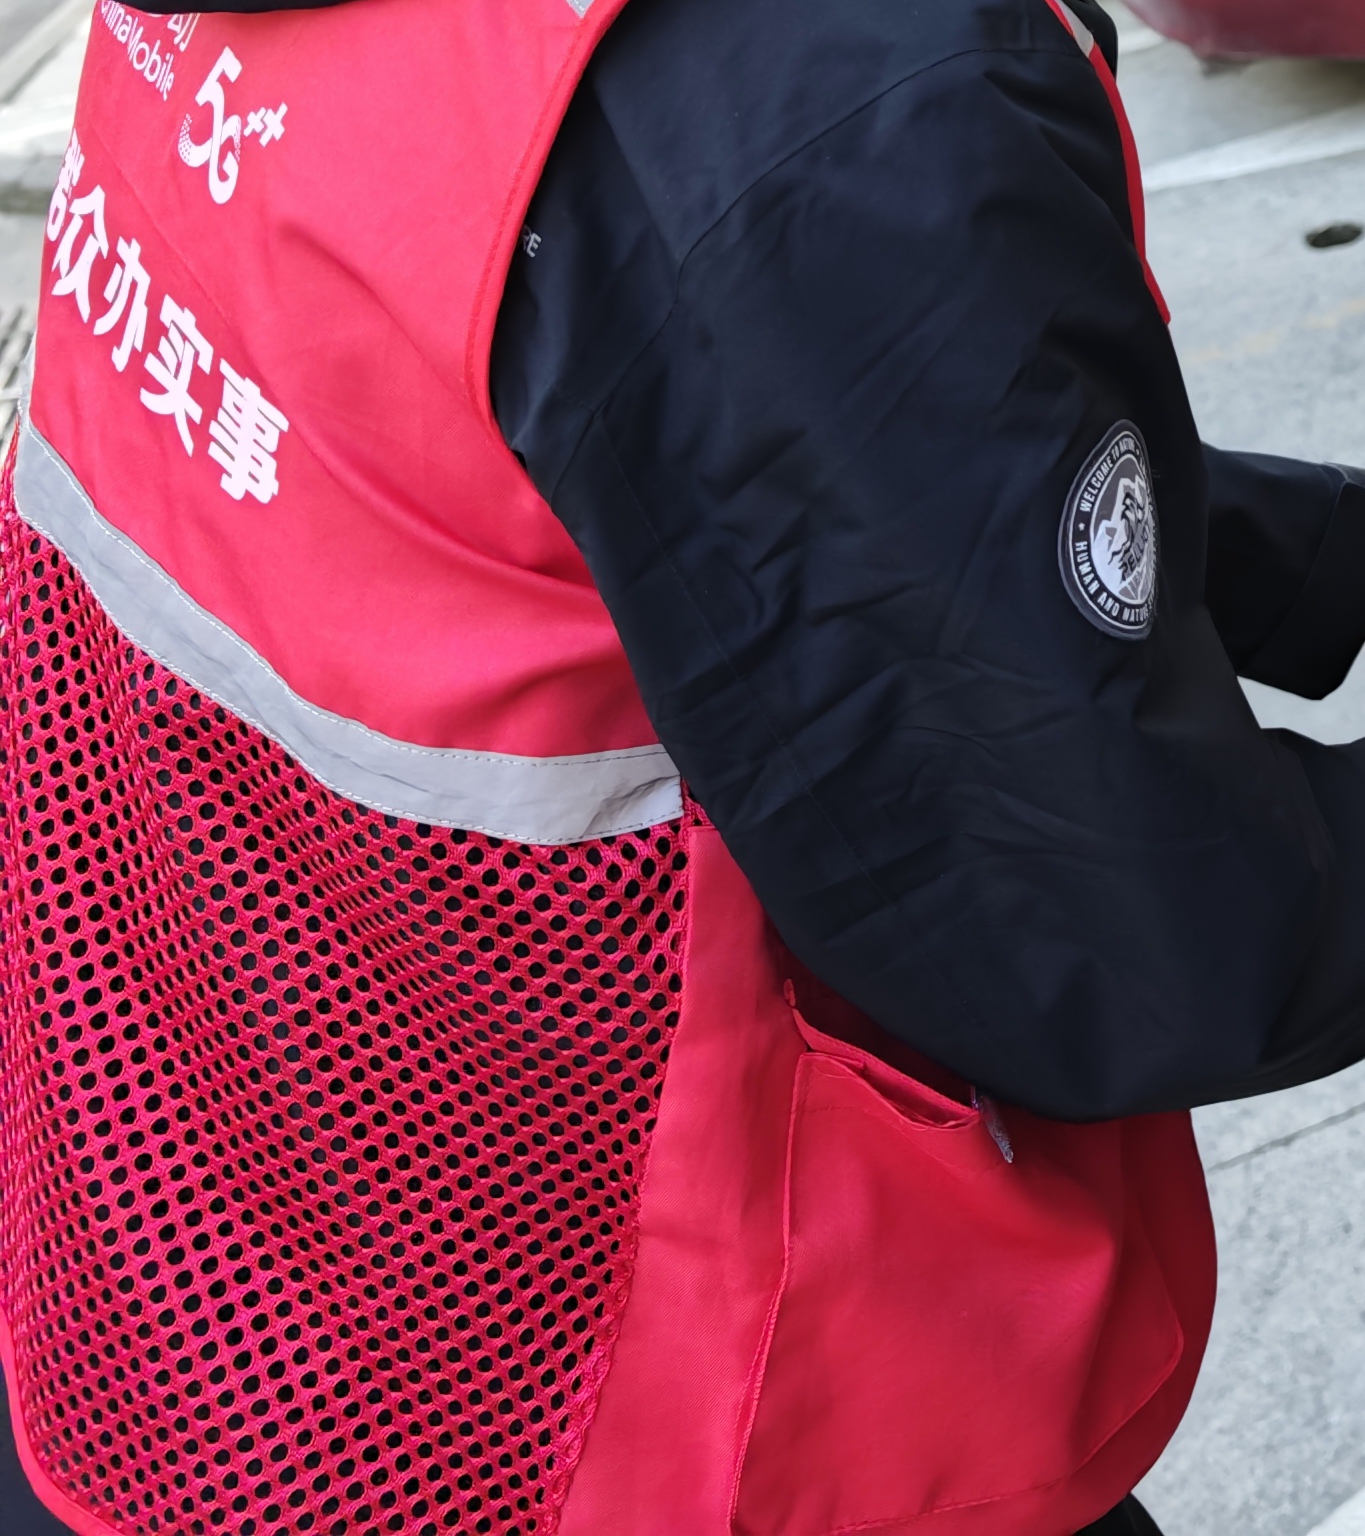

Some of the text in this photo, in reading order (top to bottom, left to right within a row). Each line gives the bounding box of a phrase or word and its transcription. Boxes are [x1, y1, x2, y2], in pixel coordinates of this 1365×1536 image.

[1080, 455, 1114, 512] WELCOME
[1075, 541, 1100, 595] HUMAN
[1097, 591, 1120, 617] AND
